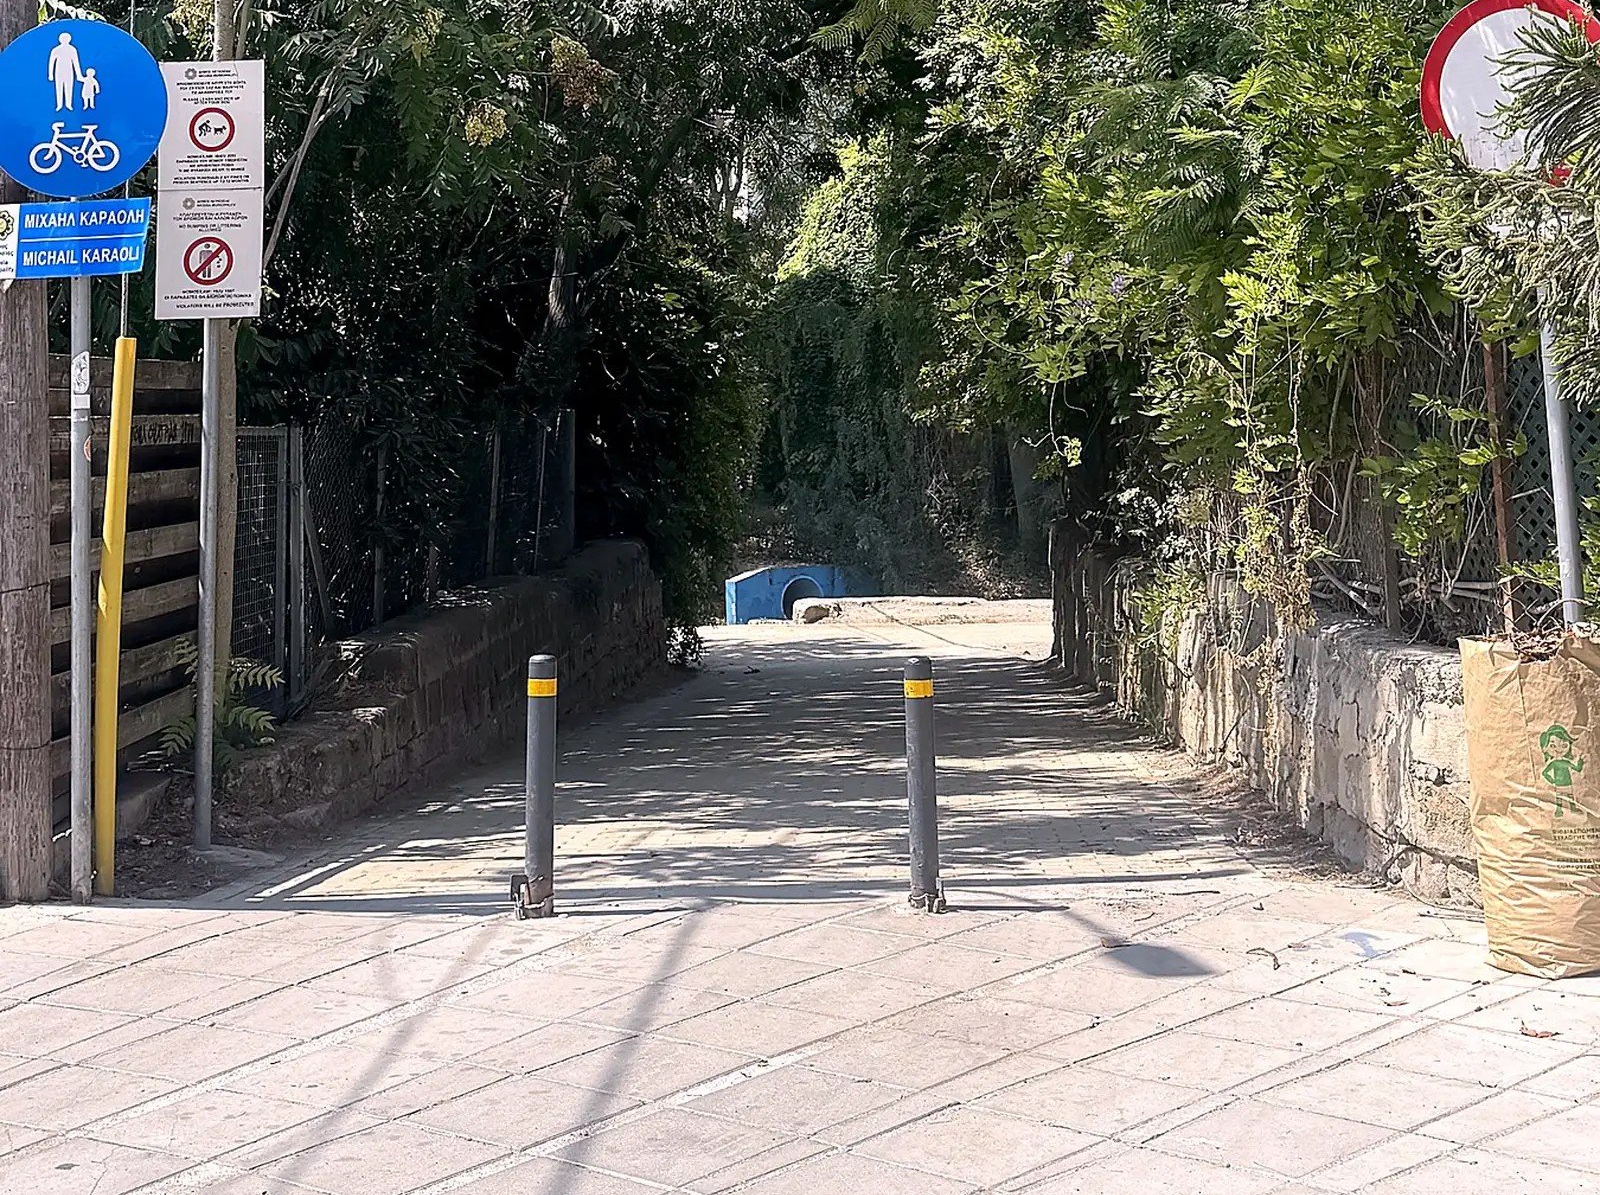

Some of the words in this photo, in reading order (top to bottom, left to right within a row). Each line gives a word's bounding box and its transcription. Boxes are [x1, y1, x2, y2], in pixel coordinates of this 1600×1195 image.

[24, 212, 75, 228] ΜΙΧΑΗΛ
[80, 209, 144, 226] ΚΑΡΑΟΛΗ
[23, 249, 78, 266] MICHAIL
[82, 246, 140, 264] KARAOLI
